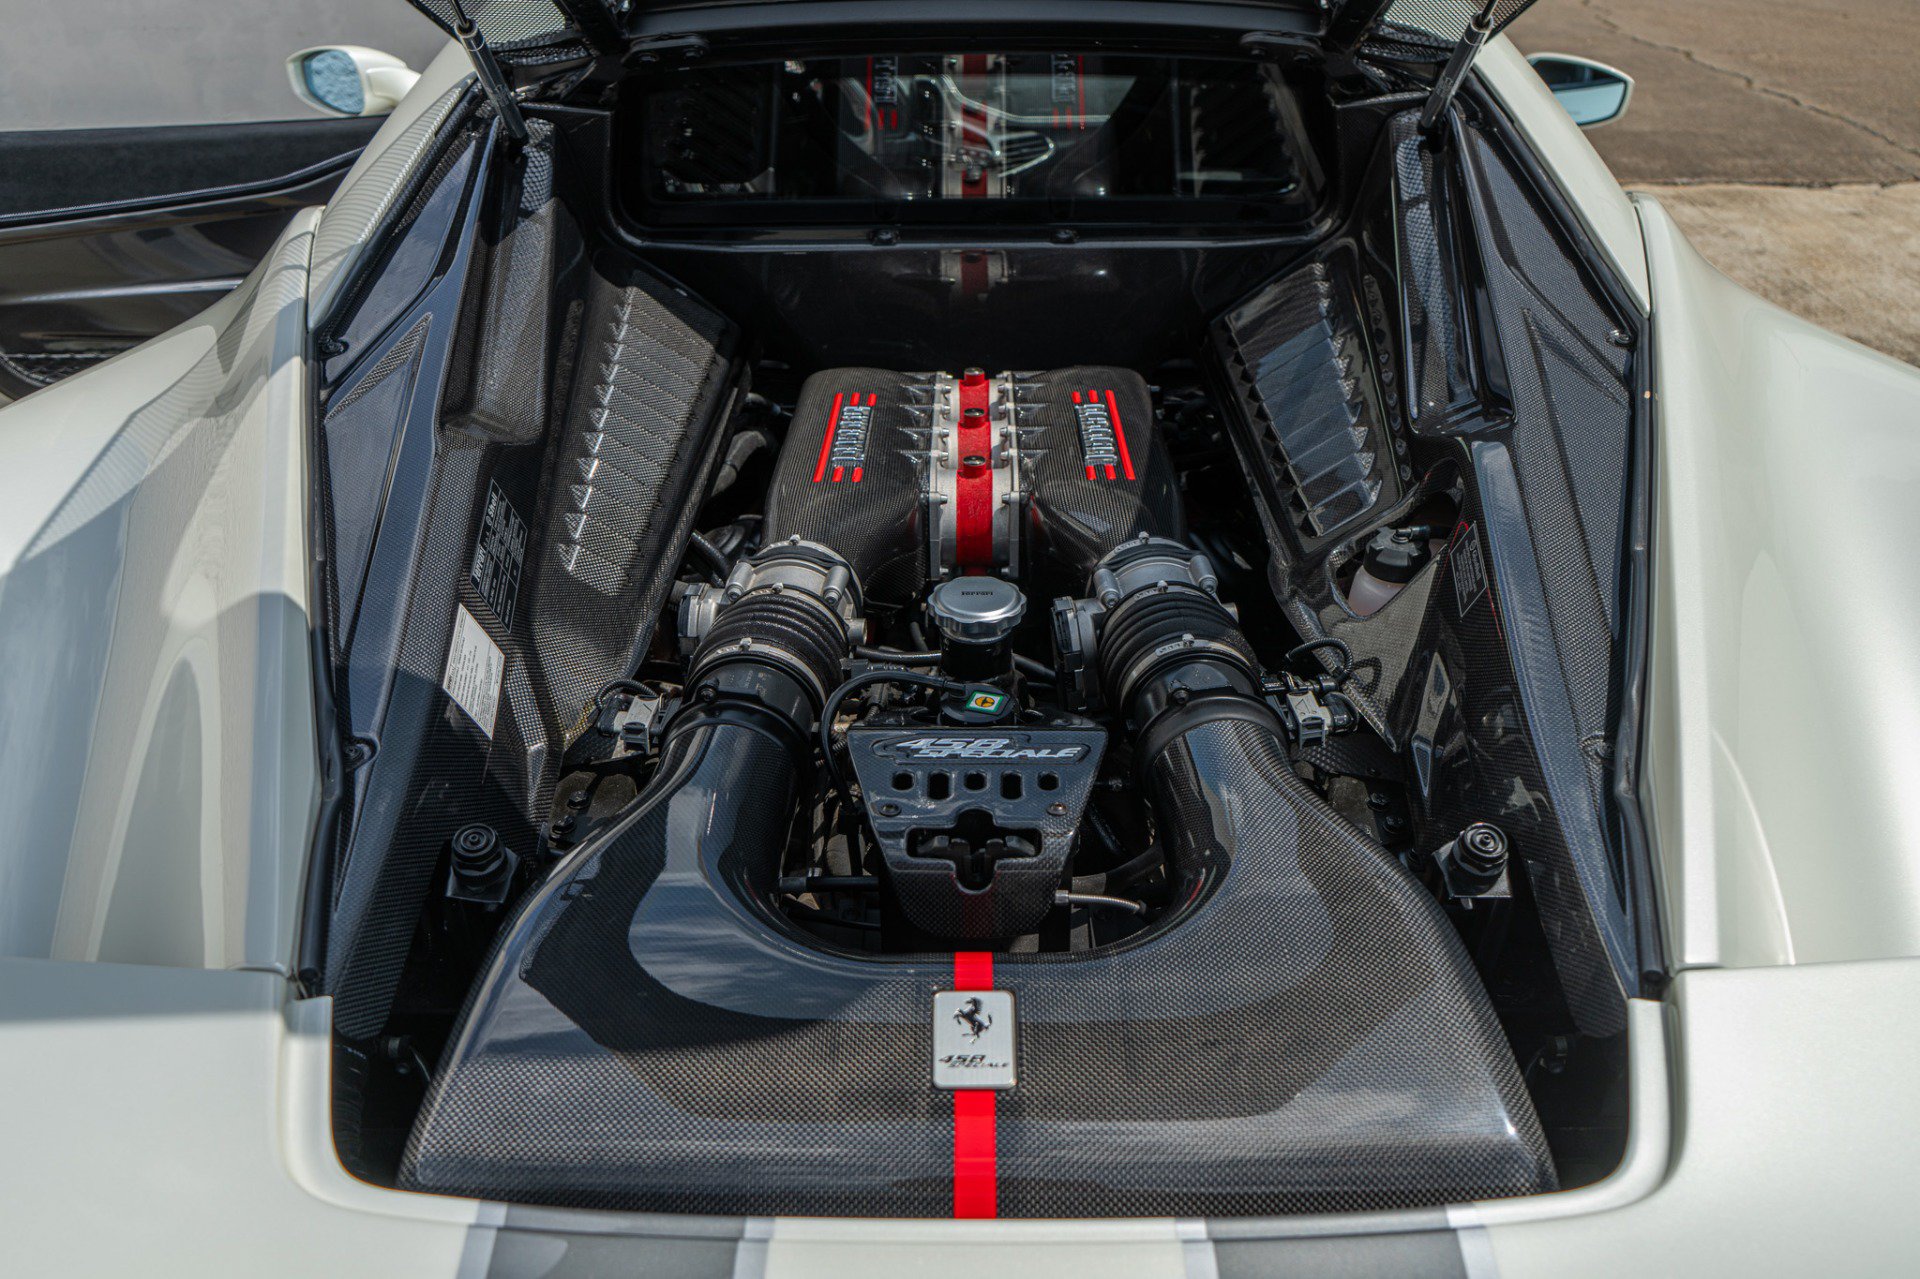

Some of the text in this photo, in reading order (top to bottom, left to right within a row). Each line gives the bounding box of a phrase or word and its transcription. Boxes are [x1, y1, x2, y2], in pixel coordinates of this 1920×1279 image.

[896, 738, 1009, 751] 458
[913, 747, 1082, 758] SPECIALE
[938, 1054, 986, 1063] 458
